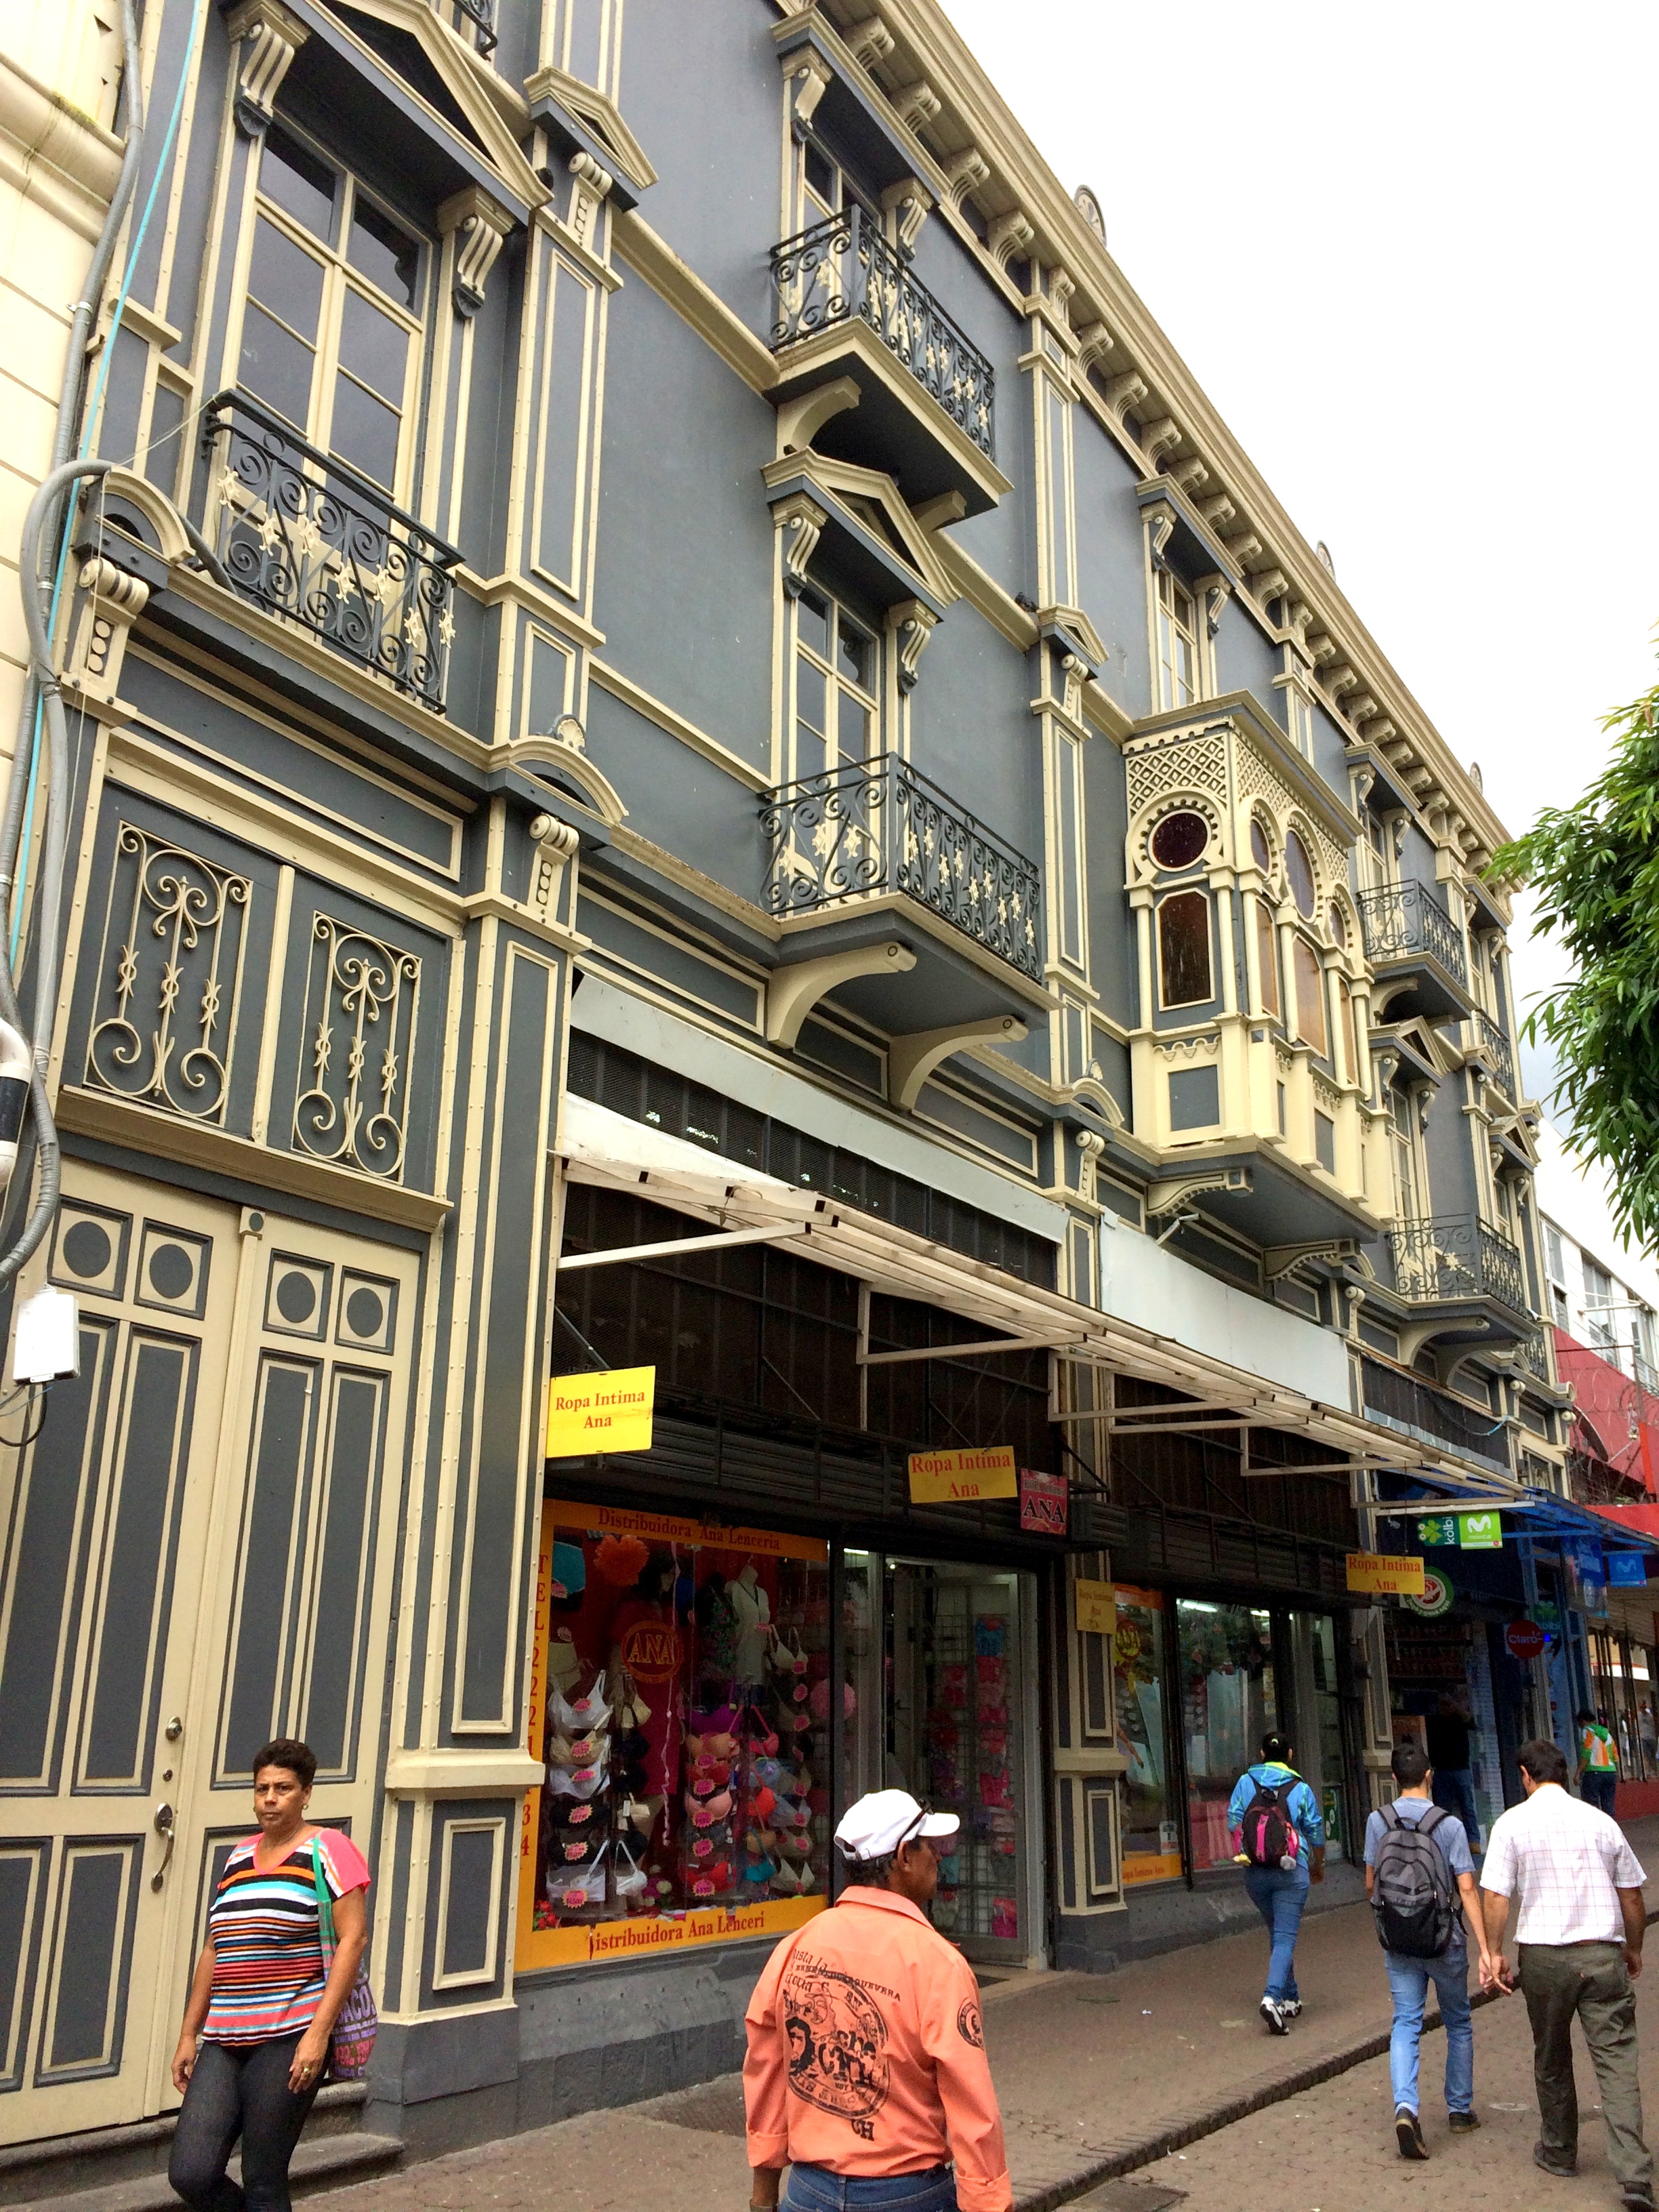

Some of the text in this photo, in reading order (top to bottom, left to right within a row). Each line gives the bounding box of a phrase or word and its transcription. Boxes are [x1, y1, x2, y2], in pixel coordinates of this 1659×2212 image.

[556, 1390, 645, 1412] Ropa Intima
[583, 1415, 613, 1429] Ana
[911, 1450, 1011, 1477] Ropa Intima
[947, 1481, 981, 1498] Ana
[1023, 1496, 1066, 1523] ANA
[598, 1507, 781, 1551] Distribuidora Ana Lenceria
[1348, 1556, 1421, 1574] Ropa Intima
[1374, 1577, 1397, 1591] Ana
[628, 1632, 676, 1665] ANA
[590, 1922, 683, 1952] istribuidora
[688, 1919, 714, 1938] Ana
